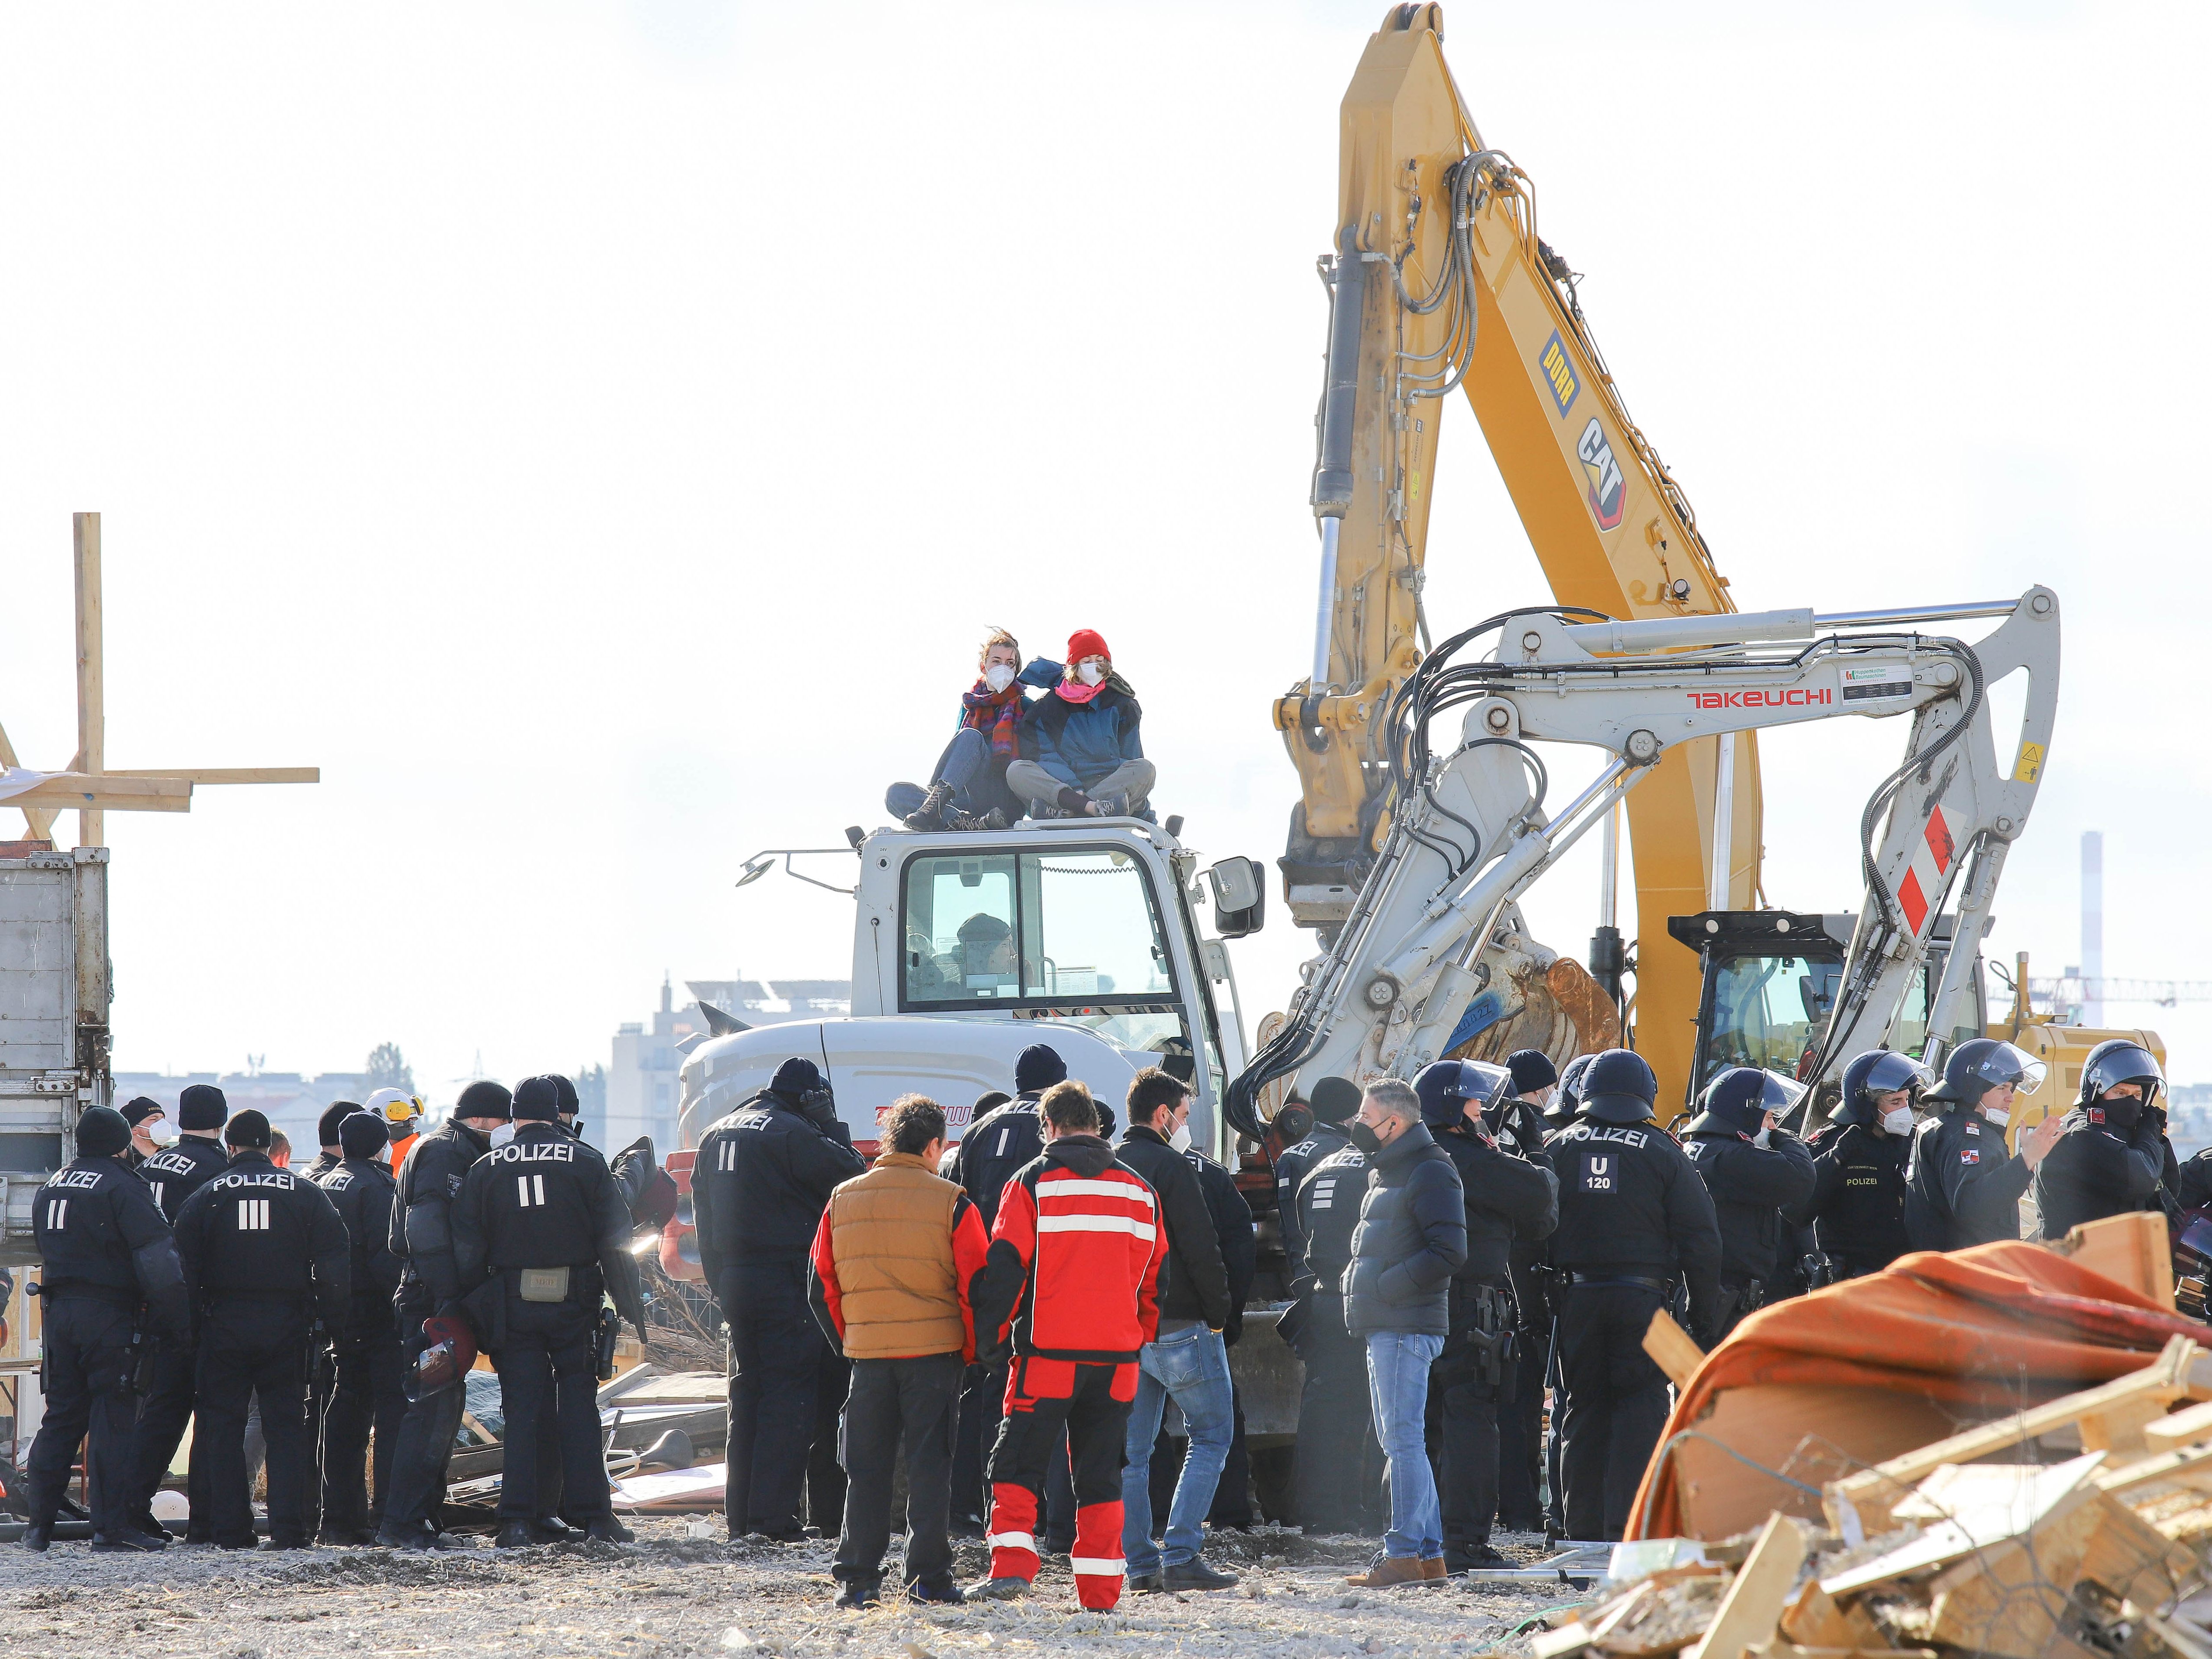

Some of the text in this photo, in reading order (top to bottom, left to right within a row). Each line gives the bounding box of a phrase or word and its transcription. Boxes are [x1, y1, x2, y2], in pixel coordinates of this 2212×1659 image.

[1578, 418, 1624, 506] CAT
[1561, 1127, 1649, 1149] POLIZEI
[491, 1143, 574, 1166] POLIZEI
[1591, 1157, 1608, 1175] U
[213, 1174, 295, 1191] POLIZEI
[1587, 1177, 1611, 1188] 120
